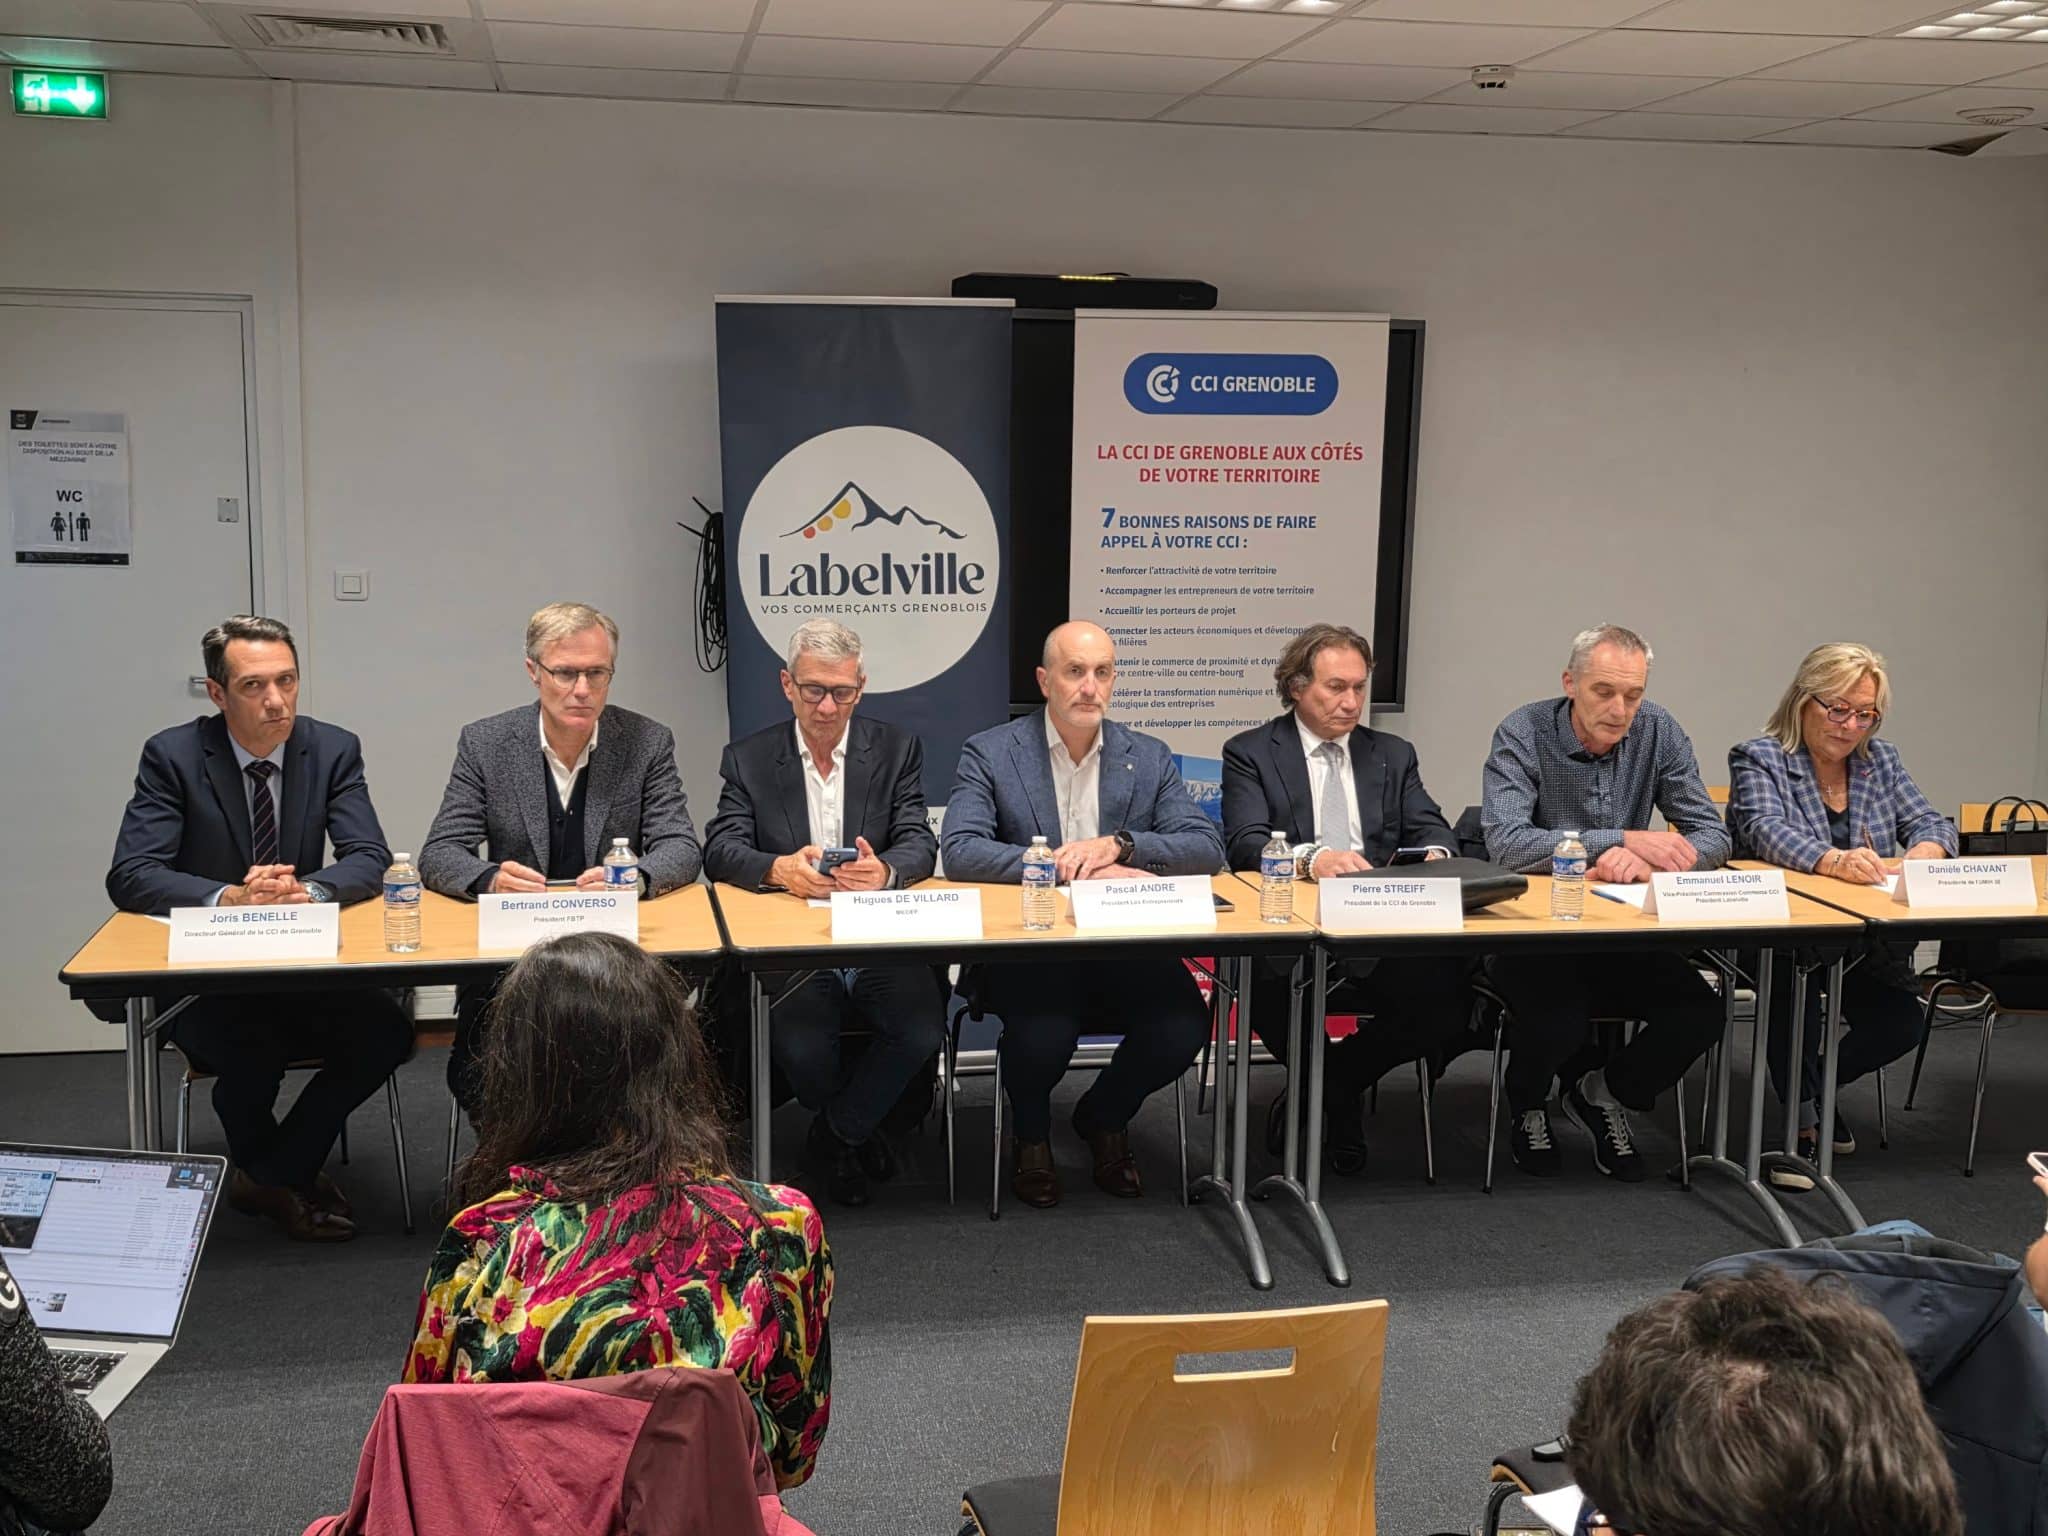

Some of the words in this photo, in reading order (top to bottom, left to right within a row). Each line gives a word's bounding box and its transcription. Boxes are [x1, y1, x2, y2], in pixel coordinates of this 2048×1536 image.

[1190, 375, 1218, 392] CCI
[1222, 376, 1316, 393] GRENOBLE
[1098, 445, 1118, 460] LA
[1122, 445, 1149, 460] CCI
[1154, 446, 1175, 460] DE
[1180, 446, 1268, 460] GRENOBLE
[1272, 446, 1306, 460] AUX
[1310, 442, 1364, 461] CÔTÉS
[1139, 468, 1160, 482] DE
[1165, 468, 1219, 482] VOTRE
[1224, 468, 1320, 483] TERRITOIRE
[56, 490, 83, 502] WC
[1101, 508, 1116, 528] 7
[1119, 515, 1180, 528] BONNES
[1184, 516, 1250, 528] RAISONS
[1254, 516, 1272, 528] DE
[1276, 516, 1316, 528] FAIRE
[1100, 535, 1148, 548] APPEL
[1151, 531, 1162, 548] À
[1165, 536, 1213, 548] VOTRE
[1216, 536, 1240, 548] CCI
[759, 552, 986, 598] Labelville
[1106, 566, 1147, 575] Renforcer
[1150, 566, 1200, 575] l'attractivité
[1202, 566, 1212, 575] de
[1238, 566, 1278, 575] territoire
[1104, 587, 1162, 596] Accompagner
[1164, 586, 1176, 594] les
[1178, 587, 1238, 596] entrepreneurs
[1240, 586, 1250, 594] de
[1276, 586, 1315, 594] territoire
[760, 604, 788, 614] VOS
[794, 603, 897, 616] COMMERÇANTS
[902, 602, 988, 614] GRENOBLOIS
[1104, 606, 1144, 614] Accueillir
[1146, 606, 1158, 614] les
[1160, 607, 1196, 616] porteurs
[1198, 606, 1208, 614] de
[1210, 606, 1236, 616] projet
[1150, 626, 1162, 635] les
[1164, 627, 1194, 635] acteurs
[1197, 626, 1252, 636] économiques
[1118, 638, 1147, 646] filières
[1114, 658, 1140, 666] utenir
[1142, 658, 1150, 666] le
[1196, 658, 1206, 666] de
[1208, 657, 1248, 667] proximité
[1128, 668, 1174, 677] centre-ville
[1189, 668, 1244, 678] centre-bourg
[1112, 688, 1142, 696] célérer
[1144, 688, 1152, 696] la
[1154, 688, 1216, 696] transformation
[1218, 688, 1263, 698] numérique
[1150, 700, 1166, 708] des
[1168, 700, 1215, 710] entreprises
[1134, 720, 1143, 728] et
[1144, 719, 1191, 730] développer
[1194, 719, 1206, 728] les
[1208, 718, 1262, 729] compétences
[1963, 864, 2008, 873] CHAVANT
[1676, 874, 1724, 884] Emmanuel
[1726, 874, 1762, 884] LENOIR
[1106, 884, 1138, 894] Pascal
[1140, 883, 1176, 892] ANDRE
[1352, 884, 1382, 893] Pierre
[1384, 884, 1426, 893] STREIFF
[501, 900, 548, 910] Bertrand
[552, 898, 617, 909] CONVERSO
[854, 895, 893, 906] Hugues
[896, 894, 910, 904] DE
[913, 893, 960, 902] VILLARD
[210, 913, 238, 924] Joris
[242, 911, 298, 923] BENELLE
